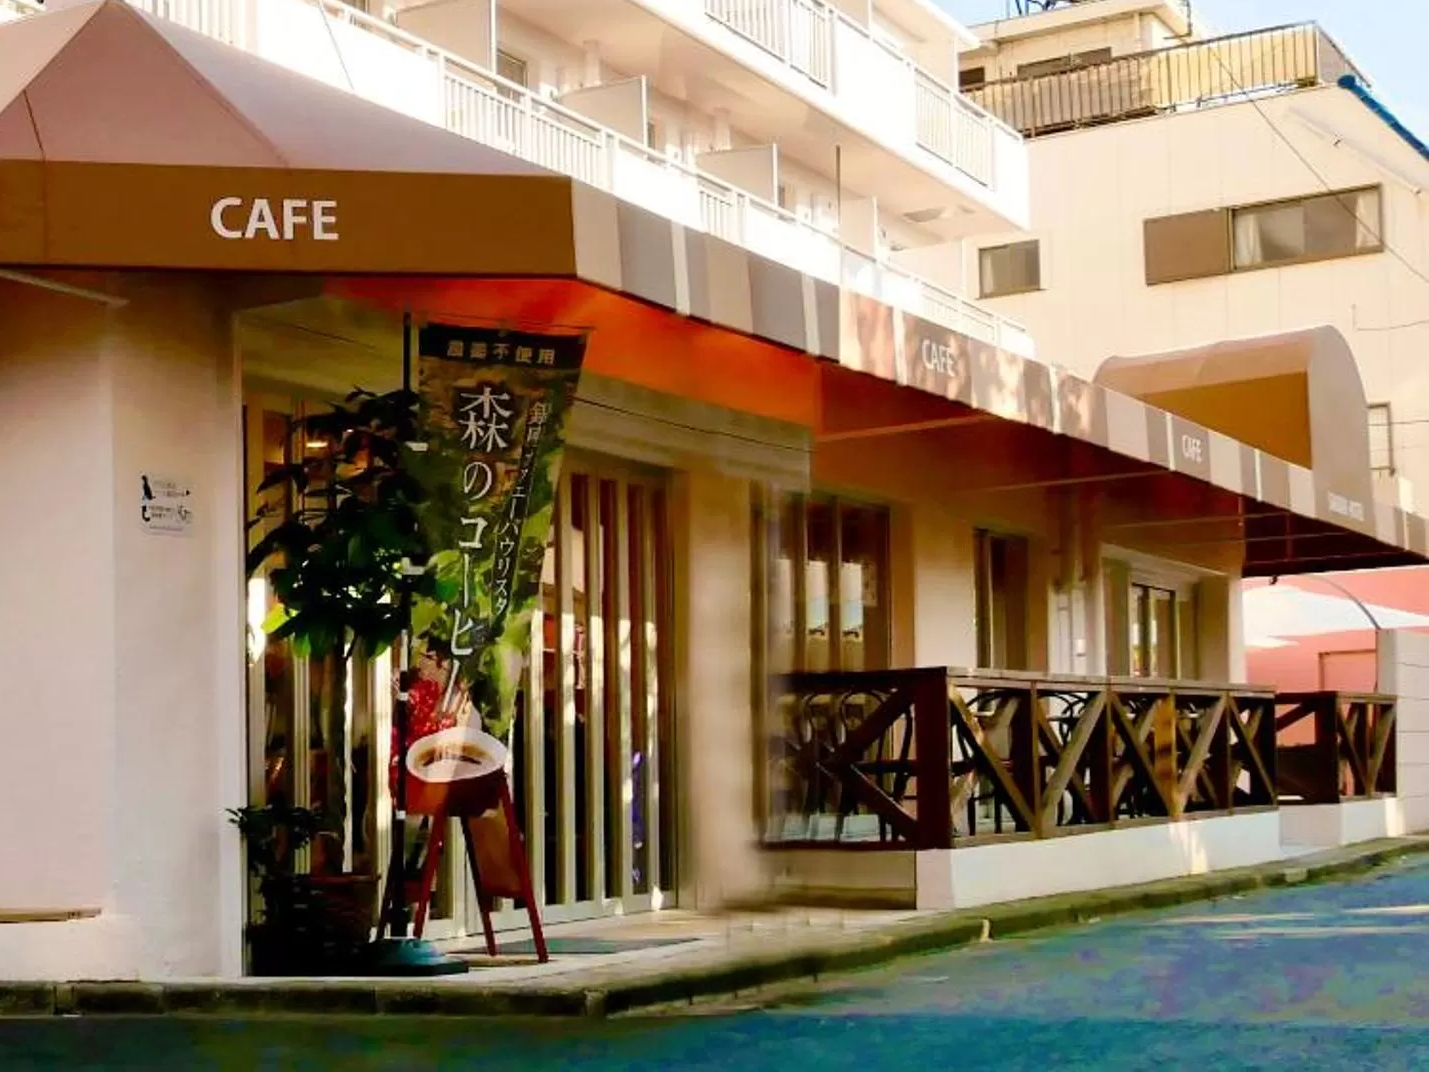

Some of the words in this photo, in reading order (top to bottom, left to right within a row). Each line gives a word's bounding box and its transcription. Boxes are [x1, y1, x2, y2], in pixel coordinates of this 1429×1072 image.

[210, 196, 339, 240] CAFE
[922, 338, 957, 377] CAFE
[1181, 434, 1203, 465] CAFE
[442, 385, 515, 712] 森のコーヒー
